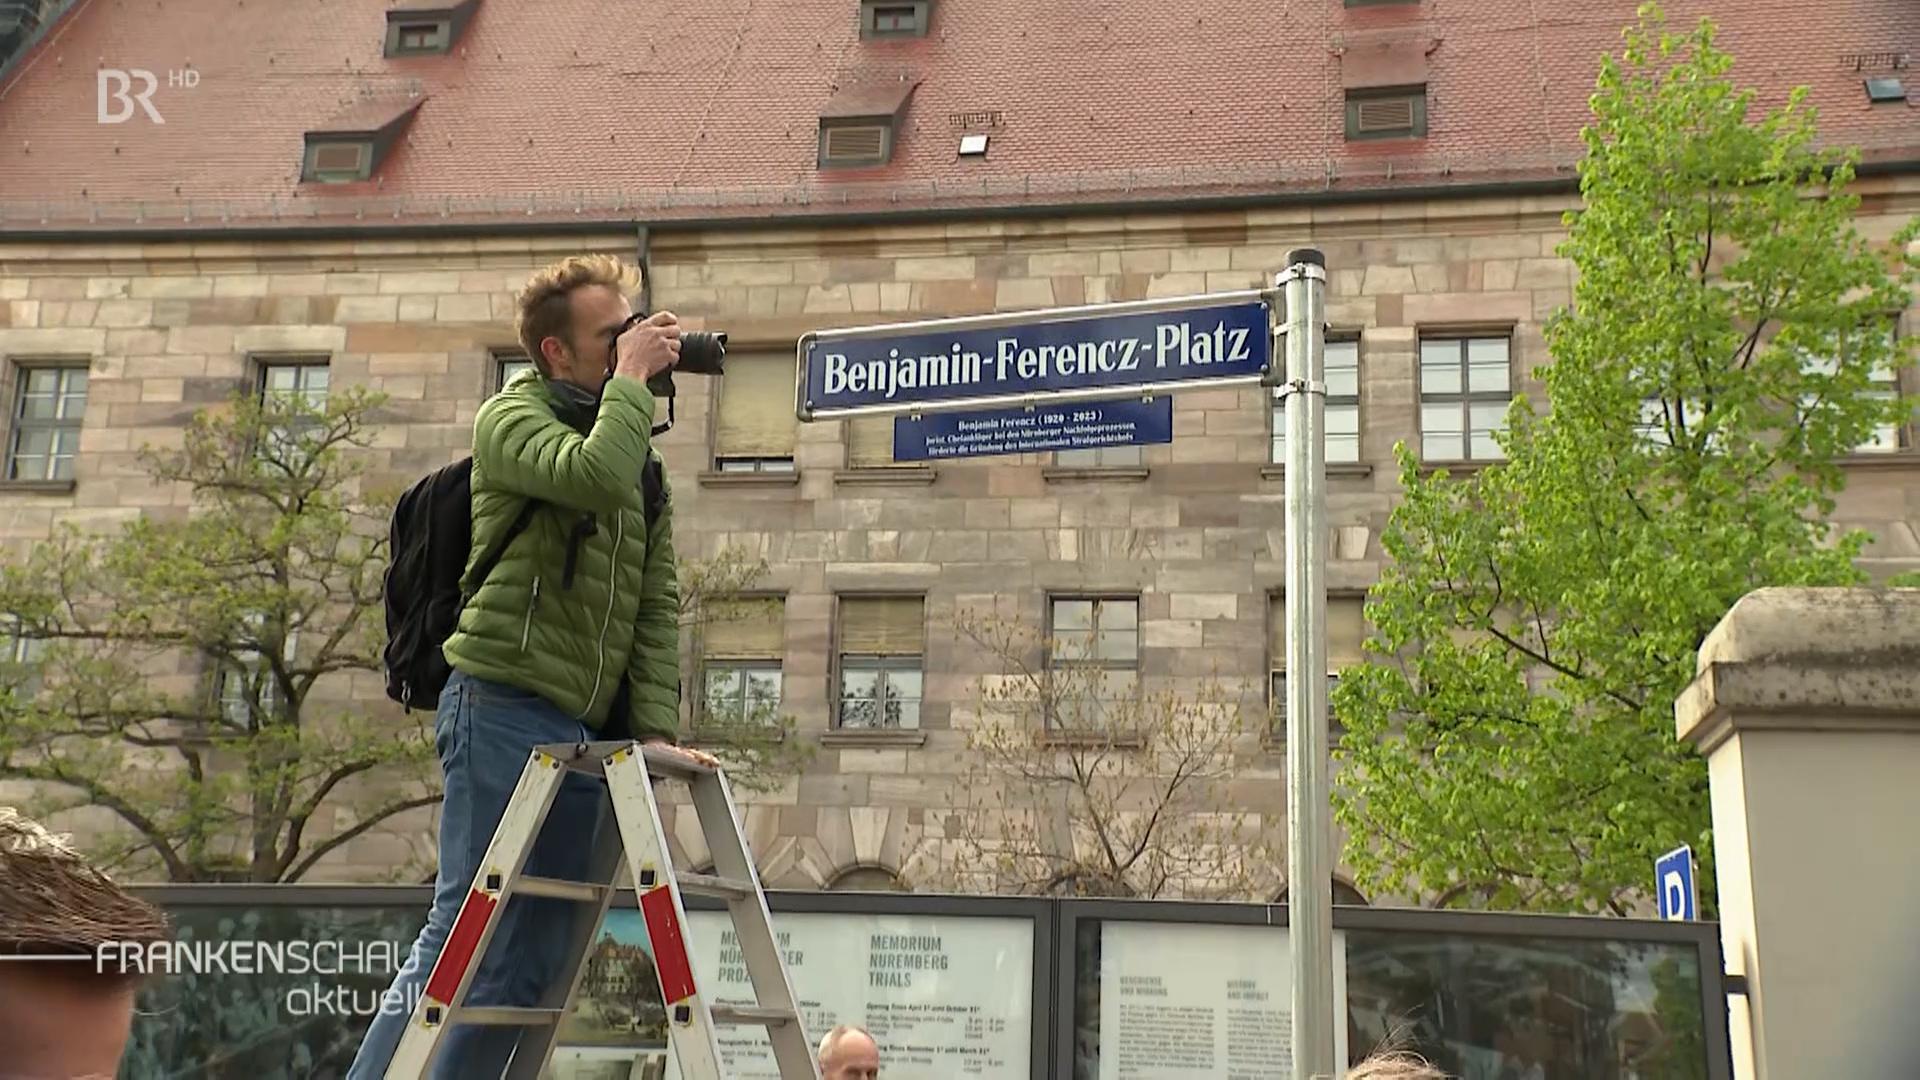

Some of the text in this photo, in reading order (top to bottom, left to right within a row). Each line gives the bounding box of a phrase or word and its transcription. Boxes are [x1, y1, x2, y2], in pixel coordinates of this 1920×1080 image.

[823, 320, 1250, 398] Benjamin-Ferencz-Platz
[958, 418, 999, 432] Benjamin
[1000, 417, 1035, 428] Ferencz
[1007, 429, 1019, 439] den
[870, 934, 942, 951] MEMORIUM
[869, 953, 949, 970] NUREMBERG
[868, 971, 912, 988] TRIALS
